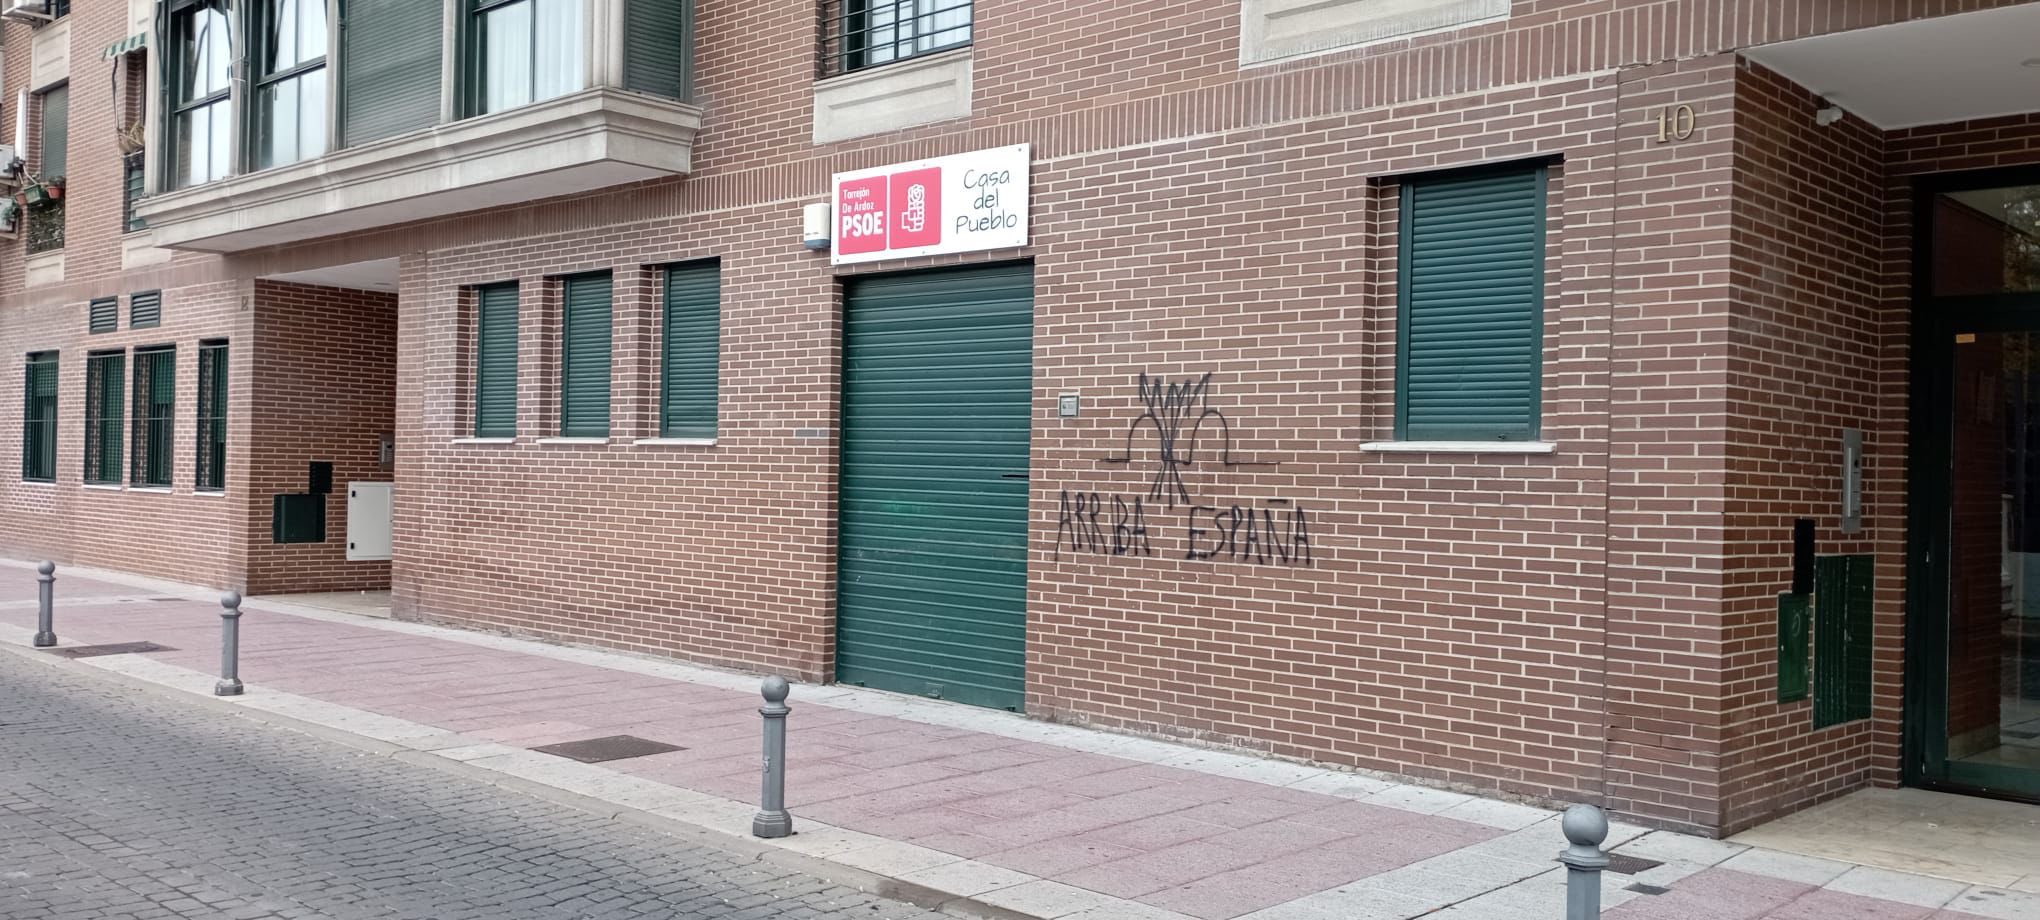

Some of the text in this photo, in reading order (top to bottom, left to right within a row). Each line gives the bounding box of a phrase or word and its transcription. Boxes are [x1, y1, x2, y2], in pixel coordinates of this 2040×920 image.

[1656, 105, 1695, 143] 10
[964, 168, 1009, 189] Casa
[843, 187, 870, 200] Torrejón
[974, 187, 998, 209] del
[842, 200, 875, 213] De Ardoz
[842, 211, 884, 238] PSOE
[956, 208, 1017, 234] Pueblo
[1054, 490, 1312, 566] ARRIBA ESPAÑA
